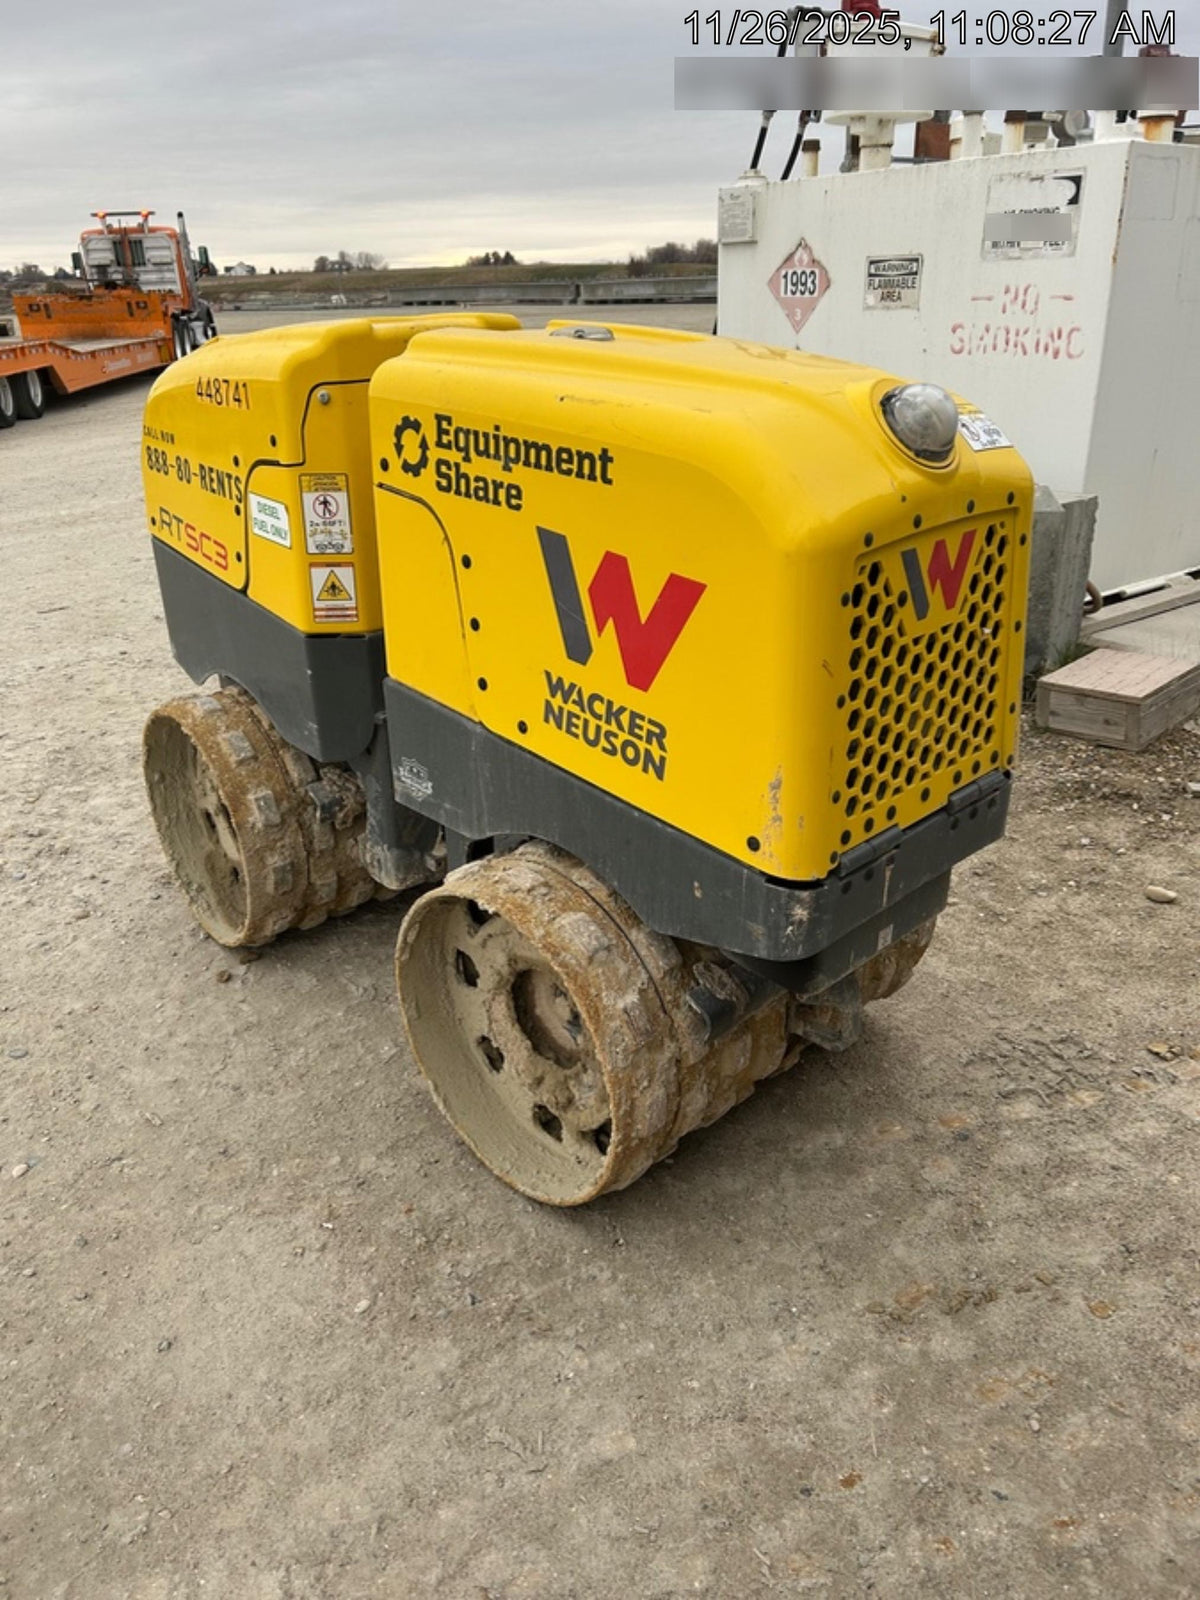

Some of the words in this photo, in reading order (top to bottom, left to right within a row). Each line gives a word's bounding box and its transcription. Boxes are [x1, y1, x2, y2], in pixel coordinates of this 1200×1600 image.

[782, 270, 818, 296] 1993
[867, 277, 917, 290] FLAMMABLE
[880, 290, 902, 302] AREA
[794, 308, 802, 321] 3
[196, 376, 250, 411] 448741
[434, 413, 614, 486] Equipment
[146, 445, 243, 504] 888-80-RENTS
[435, 459, 523, 511] Share
[544, 669, 668, 753] WACKER
[543, 699, 667, 782] NEUSON
